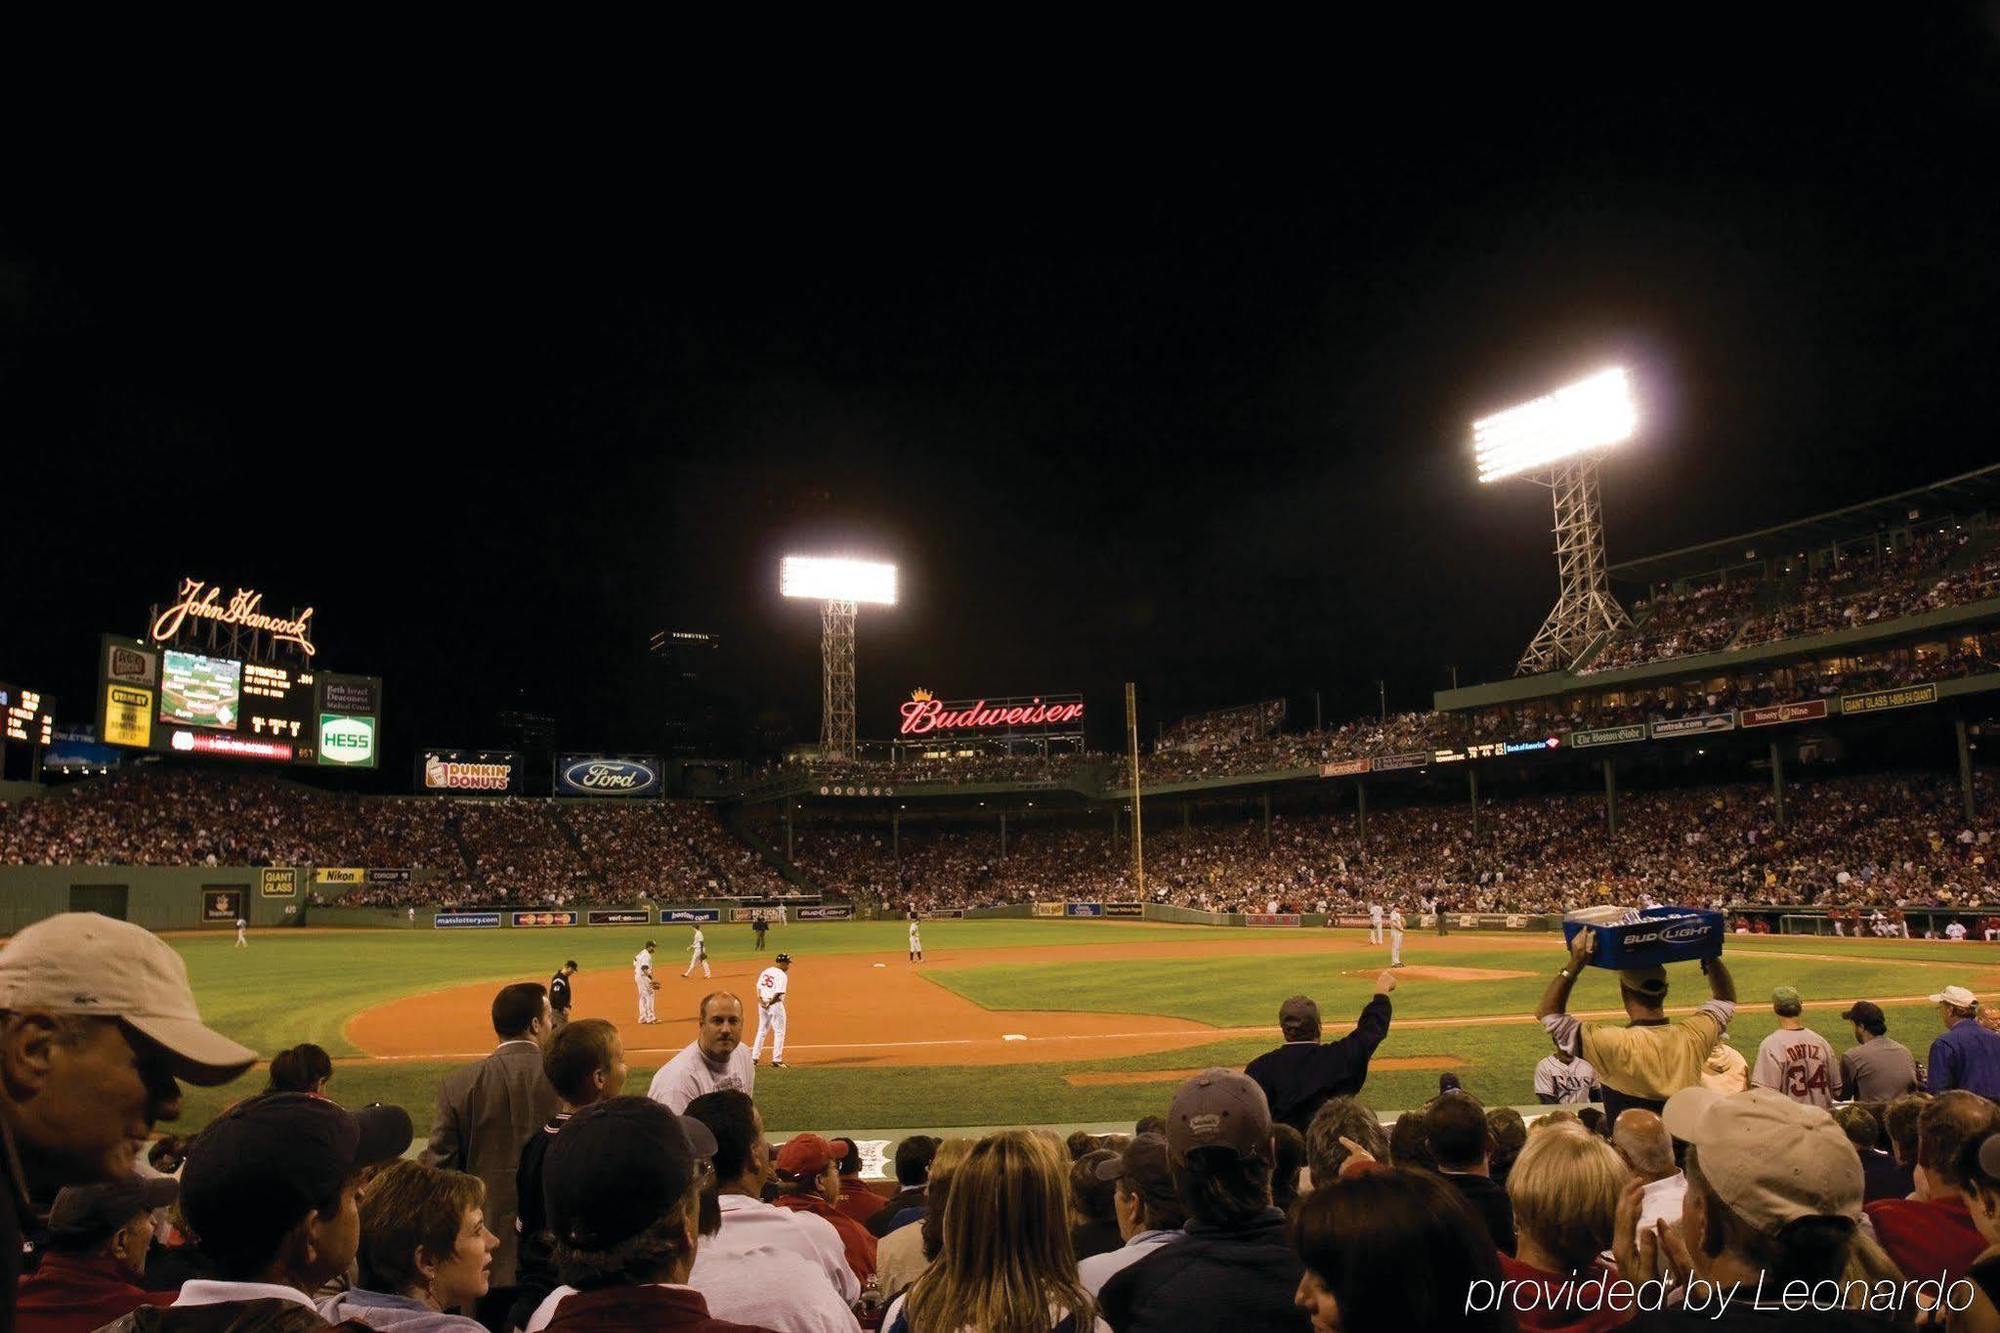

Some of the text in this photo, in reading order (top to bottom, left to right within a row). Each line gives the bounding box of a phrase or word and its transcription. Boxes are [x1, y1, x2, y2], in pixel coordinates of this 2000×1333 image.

[152, 577, 316, 656] John Hancock
[1844, 700, 1865, 712] GIANT
[1866, 696, 1889, 708] GLASS
[900, 698, 1083, 734] Budweiser
[1656, 719, 1703, 732] amtrak.com
[325, 733, 369, 749] HESS
[1577, 728, 1640, 745] The Boston Globe
[1507, 745, 1520, 753] Bank
[1525, 741, 1546, 750] America
[448, 775, 508, 790] DONUTS
[583, 764, 636, 789] Ford
[265, 872, 293, 882] GIANT
[326, 870, 355, 882] Nikon
[264, 883, 293, 893] GLASS
[436, 916, 498, 926] masslottery.com
[671, 912, 710, 921] boston.com
[1623, 925, 1713, 945] BUD LIGHT
[1786, 1043, 1821, 1062] ORTIZ
[1787, 1064, 1828, 1097] 34
